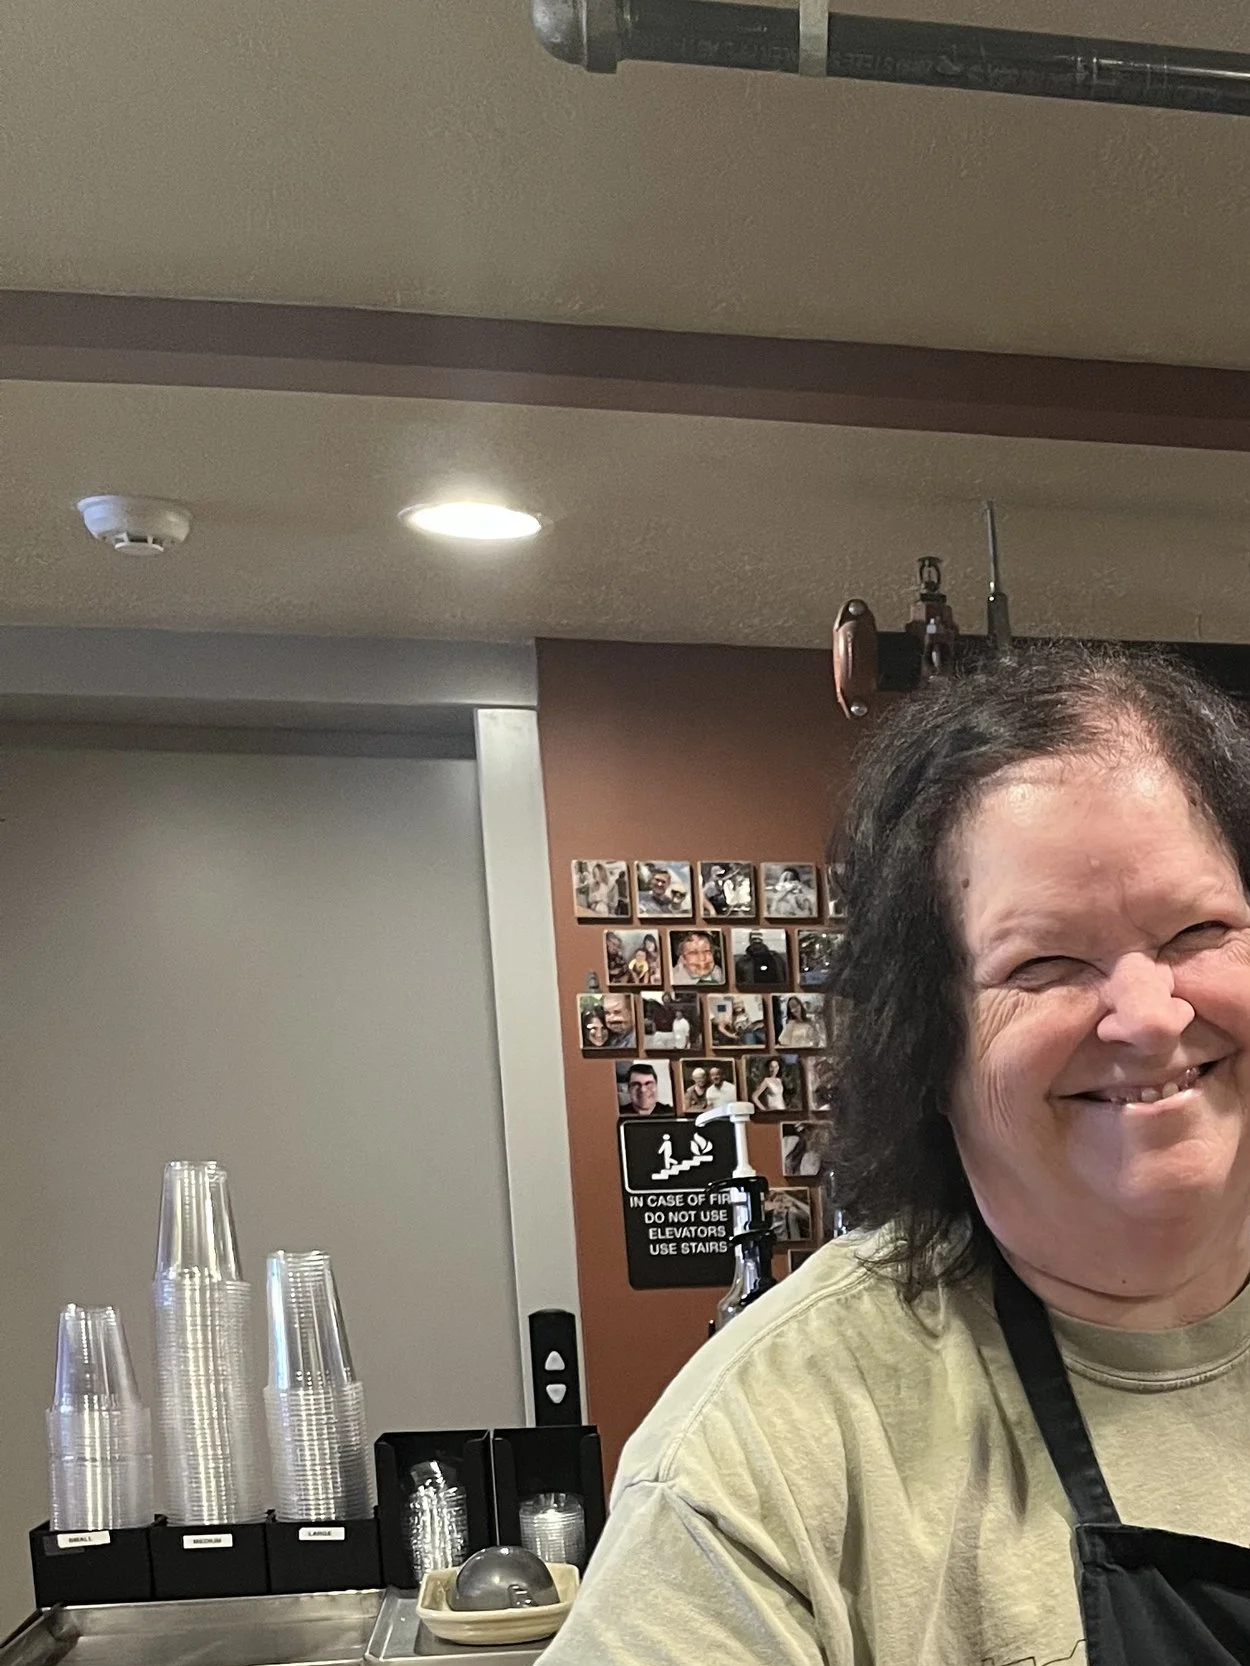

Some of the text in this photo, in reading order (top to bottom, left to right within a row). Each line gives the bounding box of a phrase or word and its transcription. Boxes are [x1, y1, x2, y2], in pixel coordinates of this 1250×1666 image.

[629, 1192, 731, 1208] IN CASE OF FIR
[644, 1209, 728, 1224] DO NOT USE
[648, 1225, 726, 1240] ELEVATORS
[650, 1241, 728, 1256] USE STAIRS
